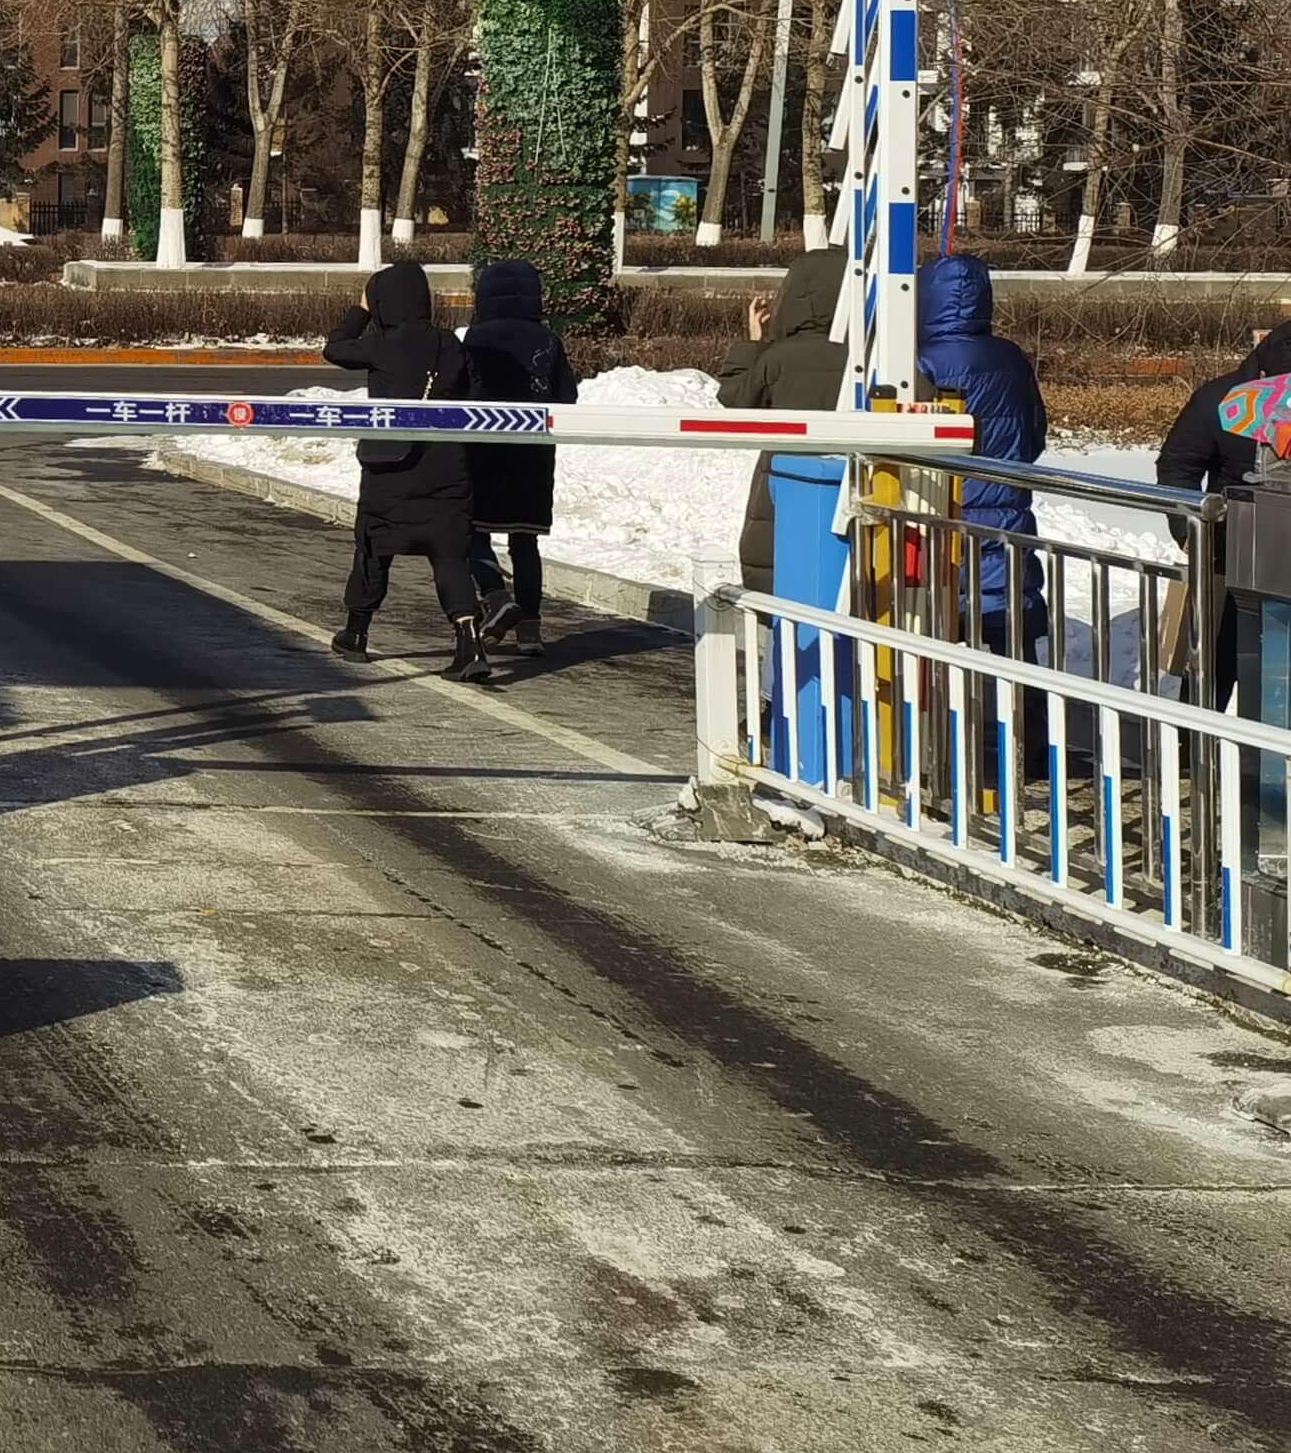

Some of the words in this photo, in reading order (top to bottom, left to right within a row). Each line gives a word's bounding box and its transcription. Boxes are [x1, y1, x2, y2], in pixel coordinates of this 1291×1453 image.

[86, 402, 191, 422] 一车一杆
[290, 406, 396, 428] 一车一杆
